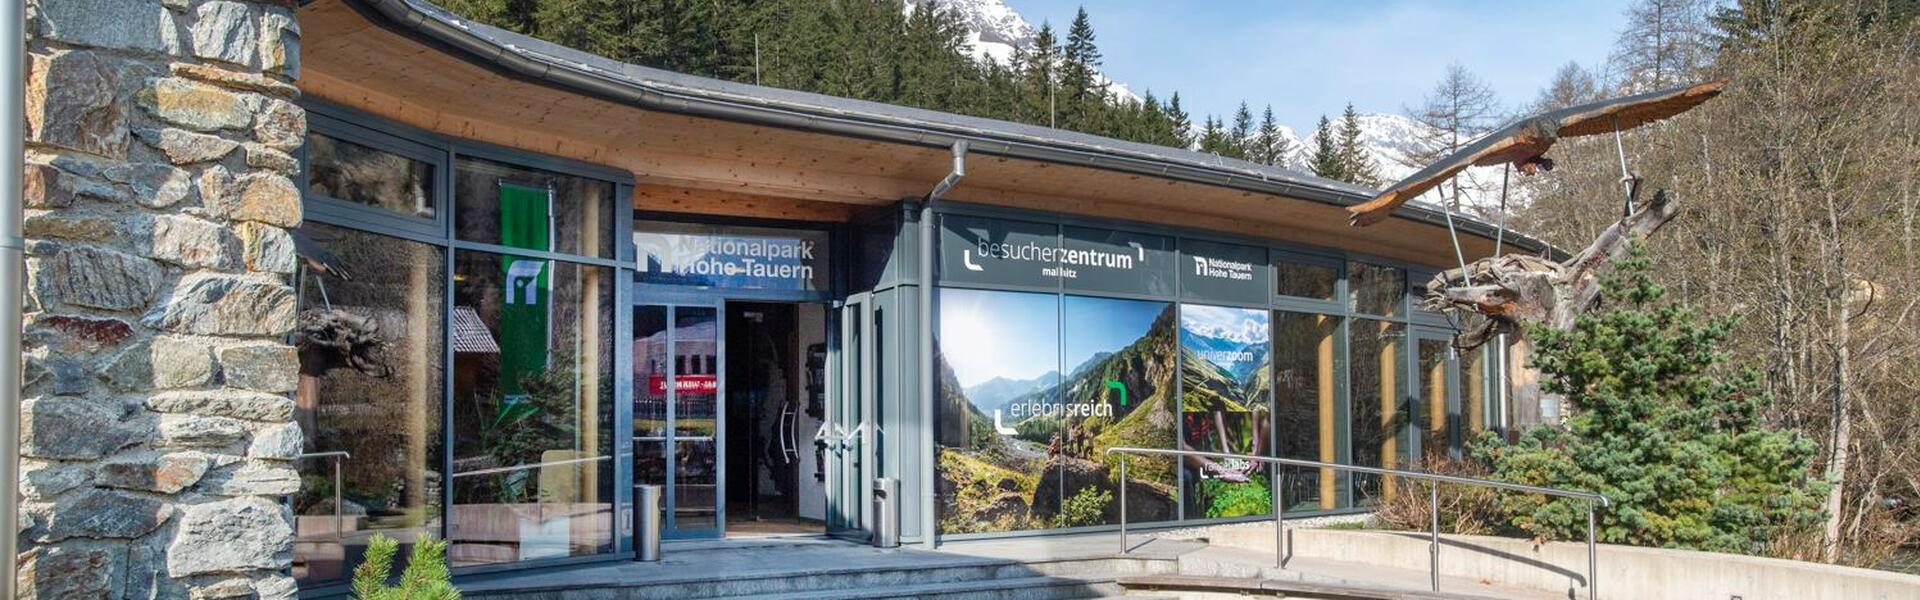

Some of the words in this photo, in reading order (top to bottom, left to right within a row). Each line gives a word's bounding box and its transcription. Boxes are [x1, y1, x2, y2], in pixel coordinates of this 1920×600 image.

[978, 237, 1133, 269] besucherzentrum
[742, 258, 813, 279] Tauern
[1209, 257, 1252, 271] Nationalpark
[1209, 268, 1228, 278] Hohe
[1229, 270, 1252, 280] Tauern
